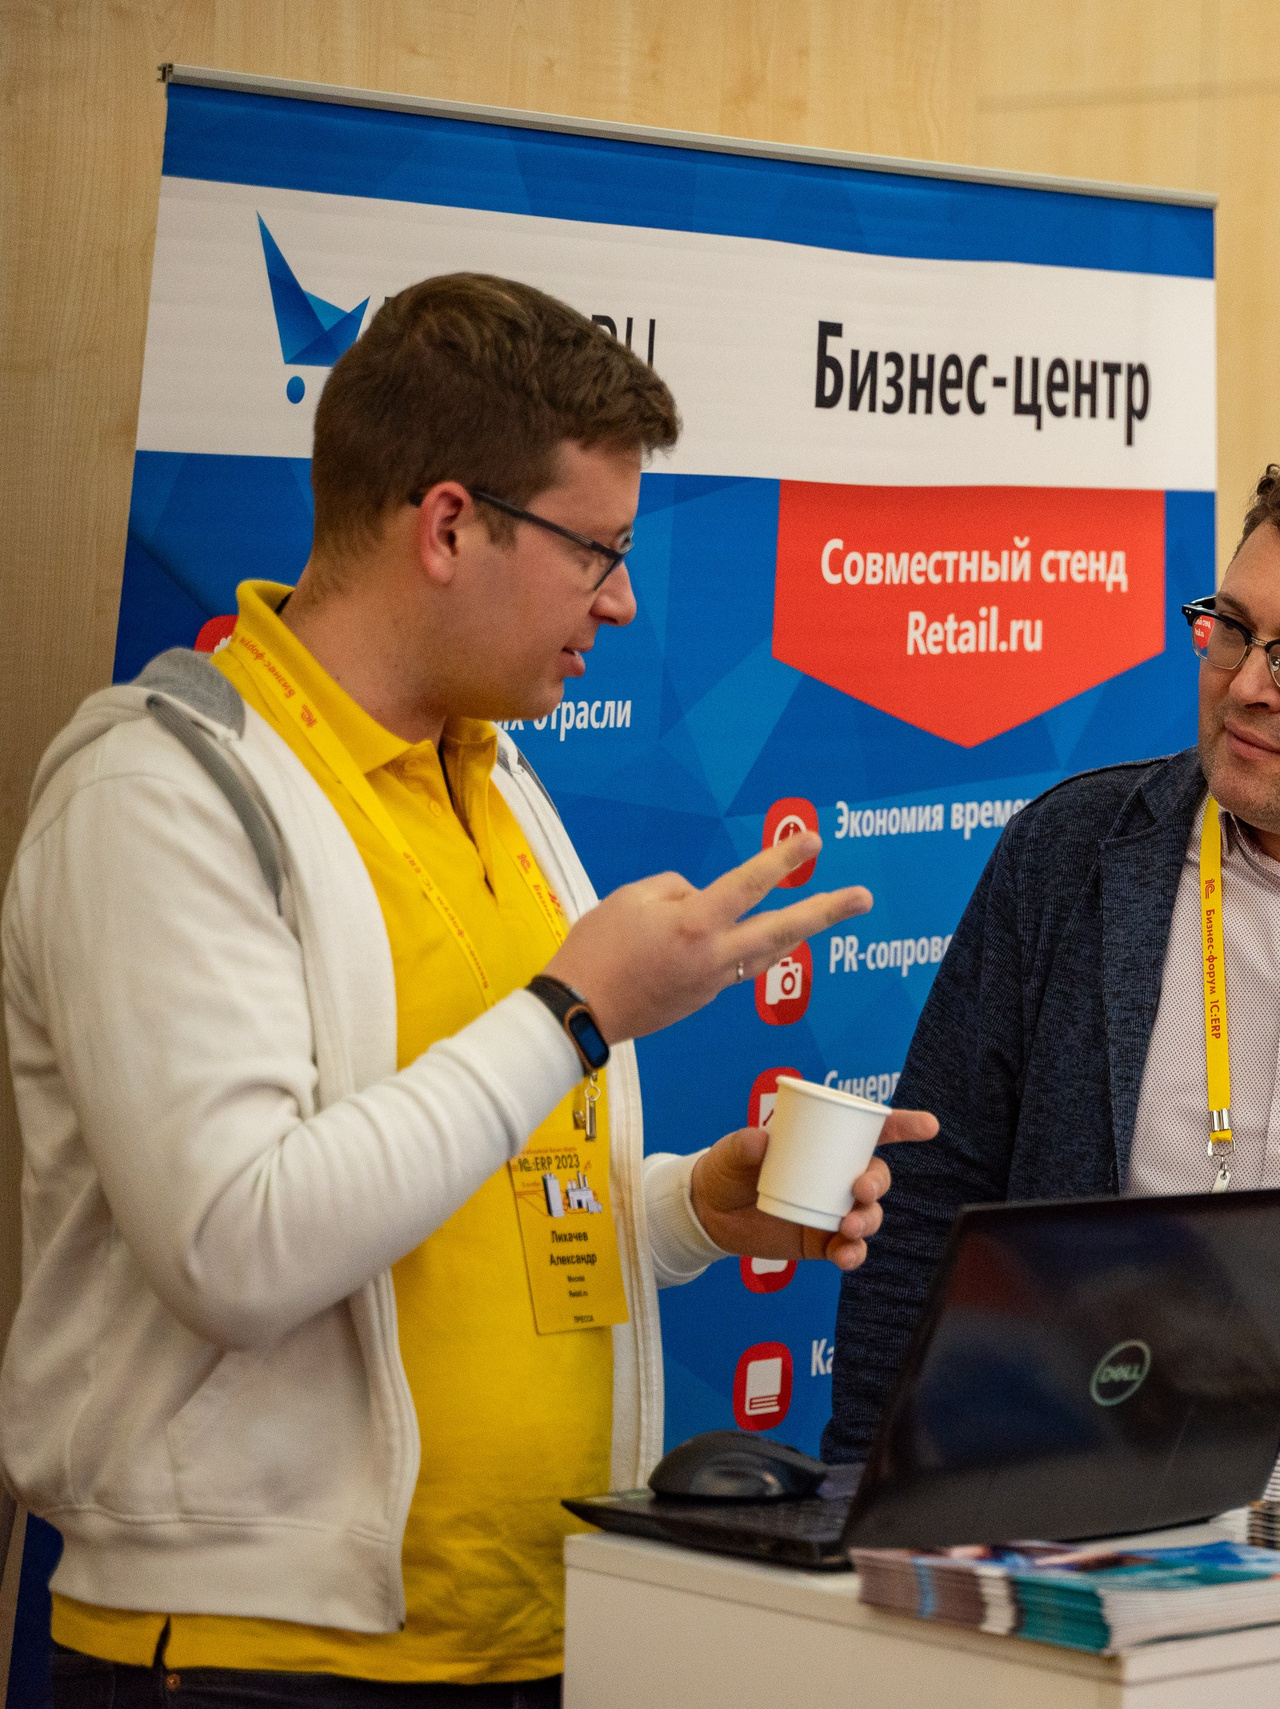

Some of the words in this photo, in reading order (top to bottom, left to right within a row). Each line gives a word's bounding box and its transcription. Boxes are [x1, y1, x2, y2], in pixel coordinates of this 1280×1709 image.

[814, 319, 1152, 447] Бизнес-центр
[820, 535, 1032, 586] Совместный
[1039, 549, 1129, 593] стенд
[906, 606, 1043, 656] Retail.ru
[834, 800, 944, 840] Экономия
[1205, 908, 1219, 996] Бизнес-форум
[1209, 1000, 1222, 1040] 1С:ERP
[554, 1154, 580, 1169] 2023
[551, 1230, 589, 1243] Лихачев
[549, 1253, 598, 1266] Александр
